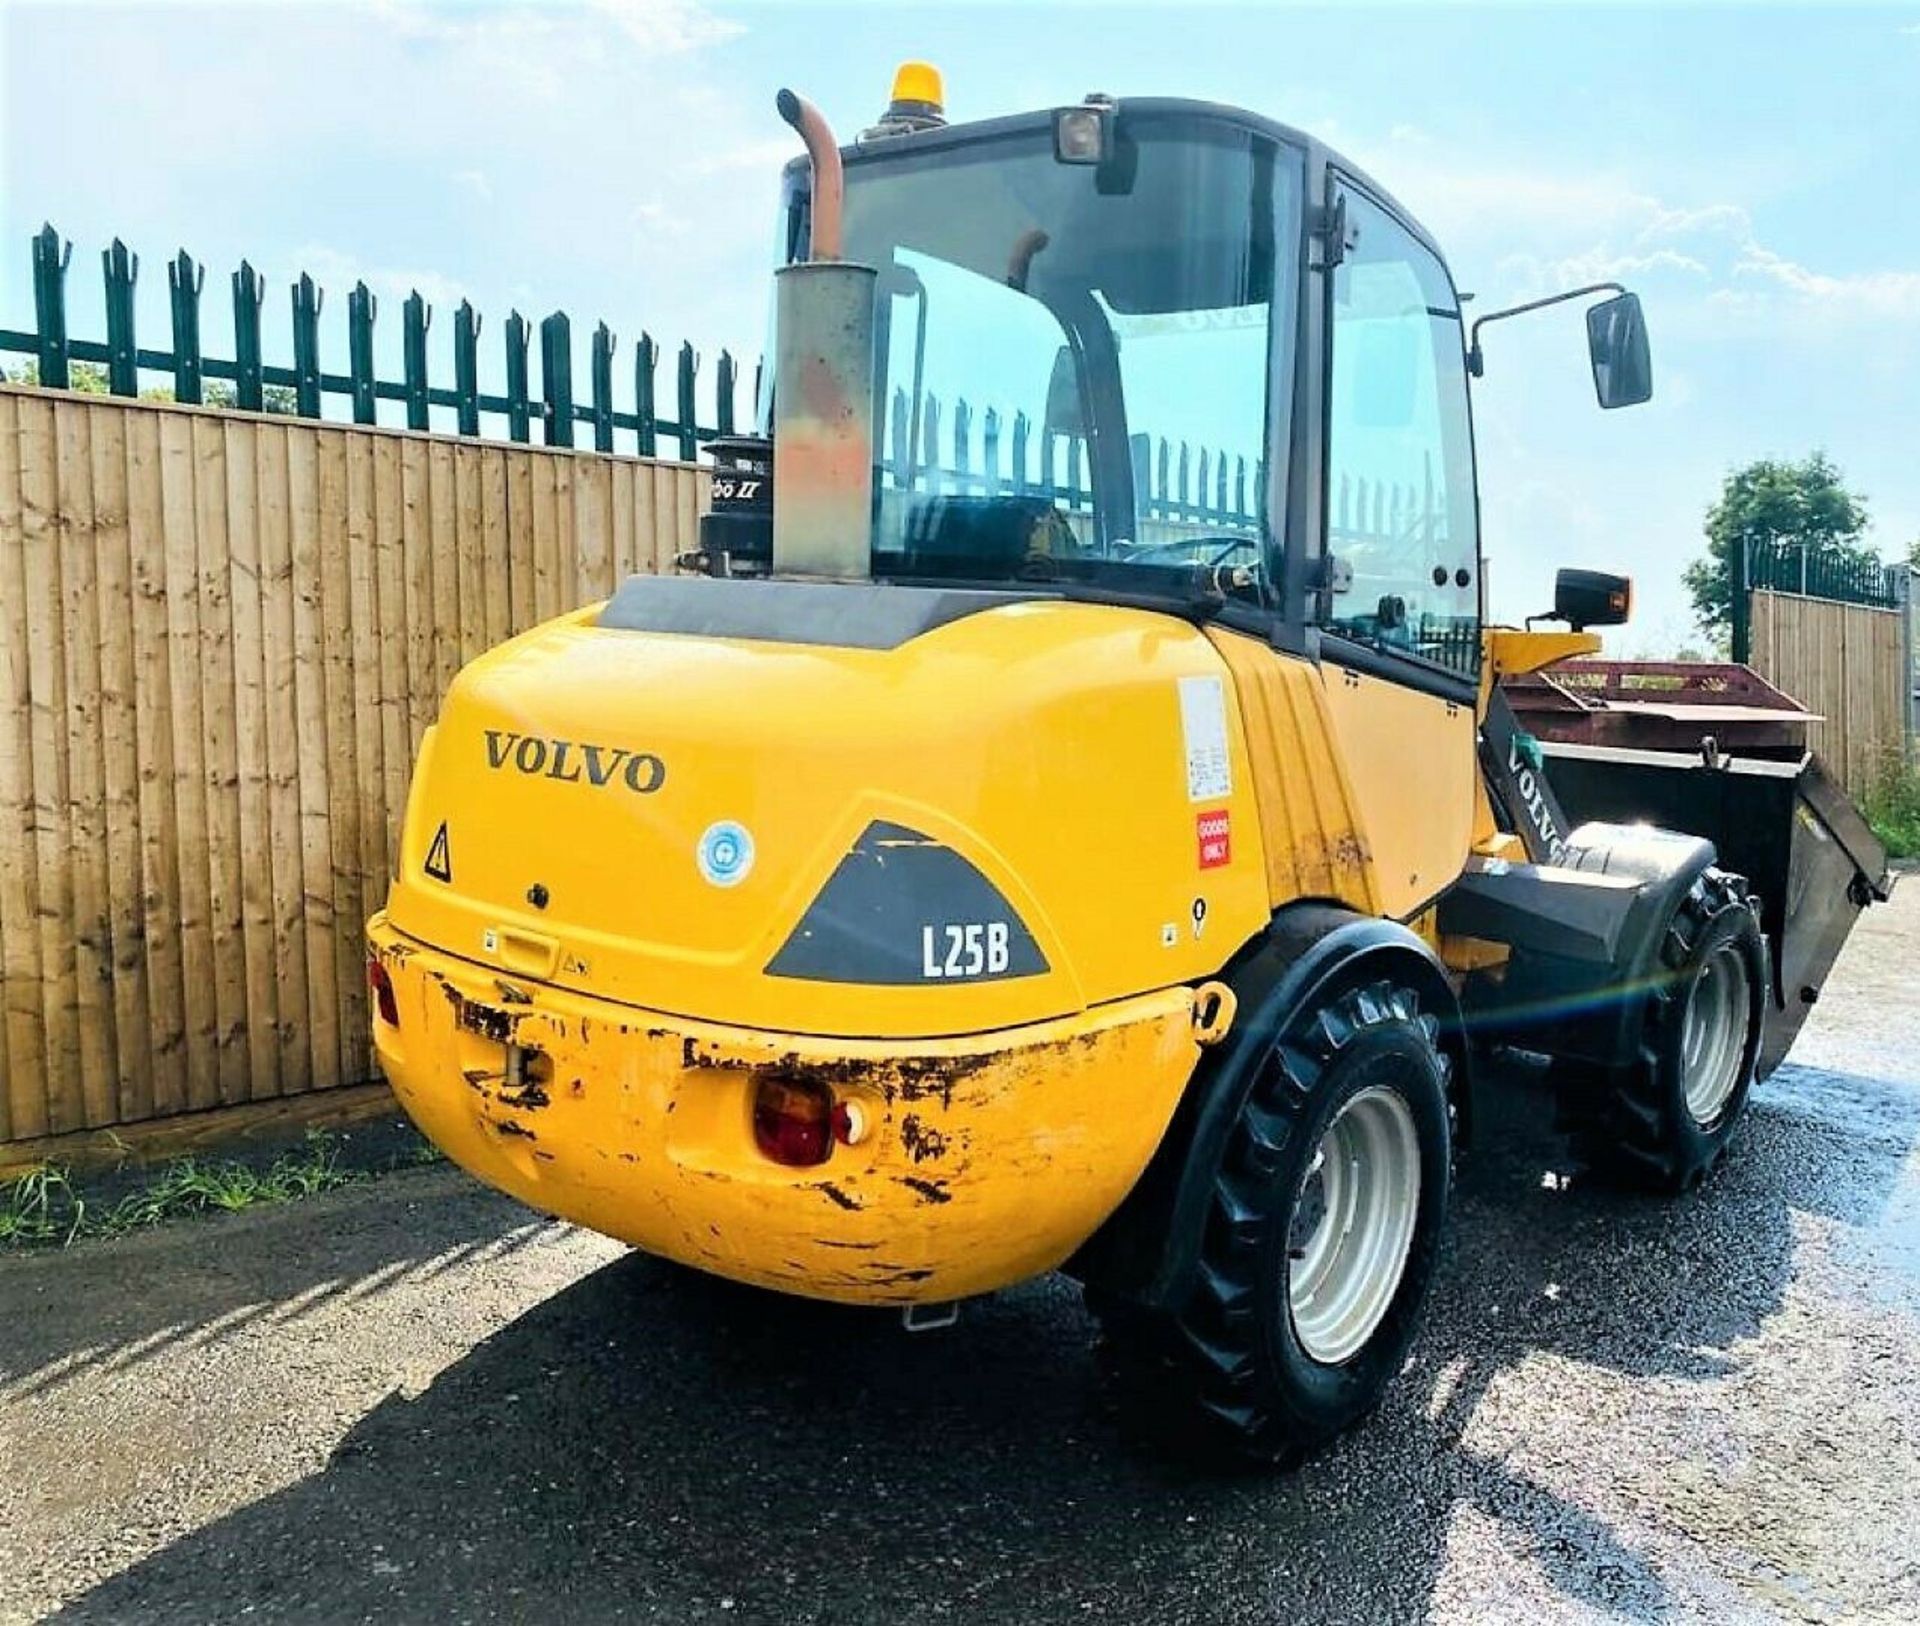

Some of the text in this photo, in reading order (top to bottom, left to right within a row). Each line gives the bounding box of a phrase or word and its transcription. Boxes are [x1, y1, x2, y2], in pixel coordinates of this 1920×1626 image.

[735, 481, 762, 498] II
[484, 730, 666, 794] VOLVO
[922, 923, 1009, 978] L25B
